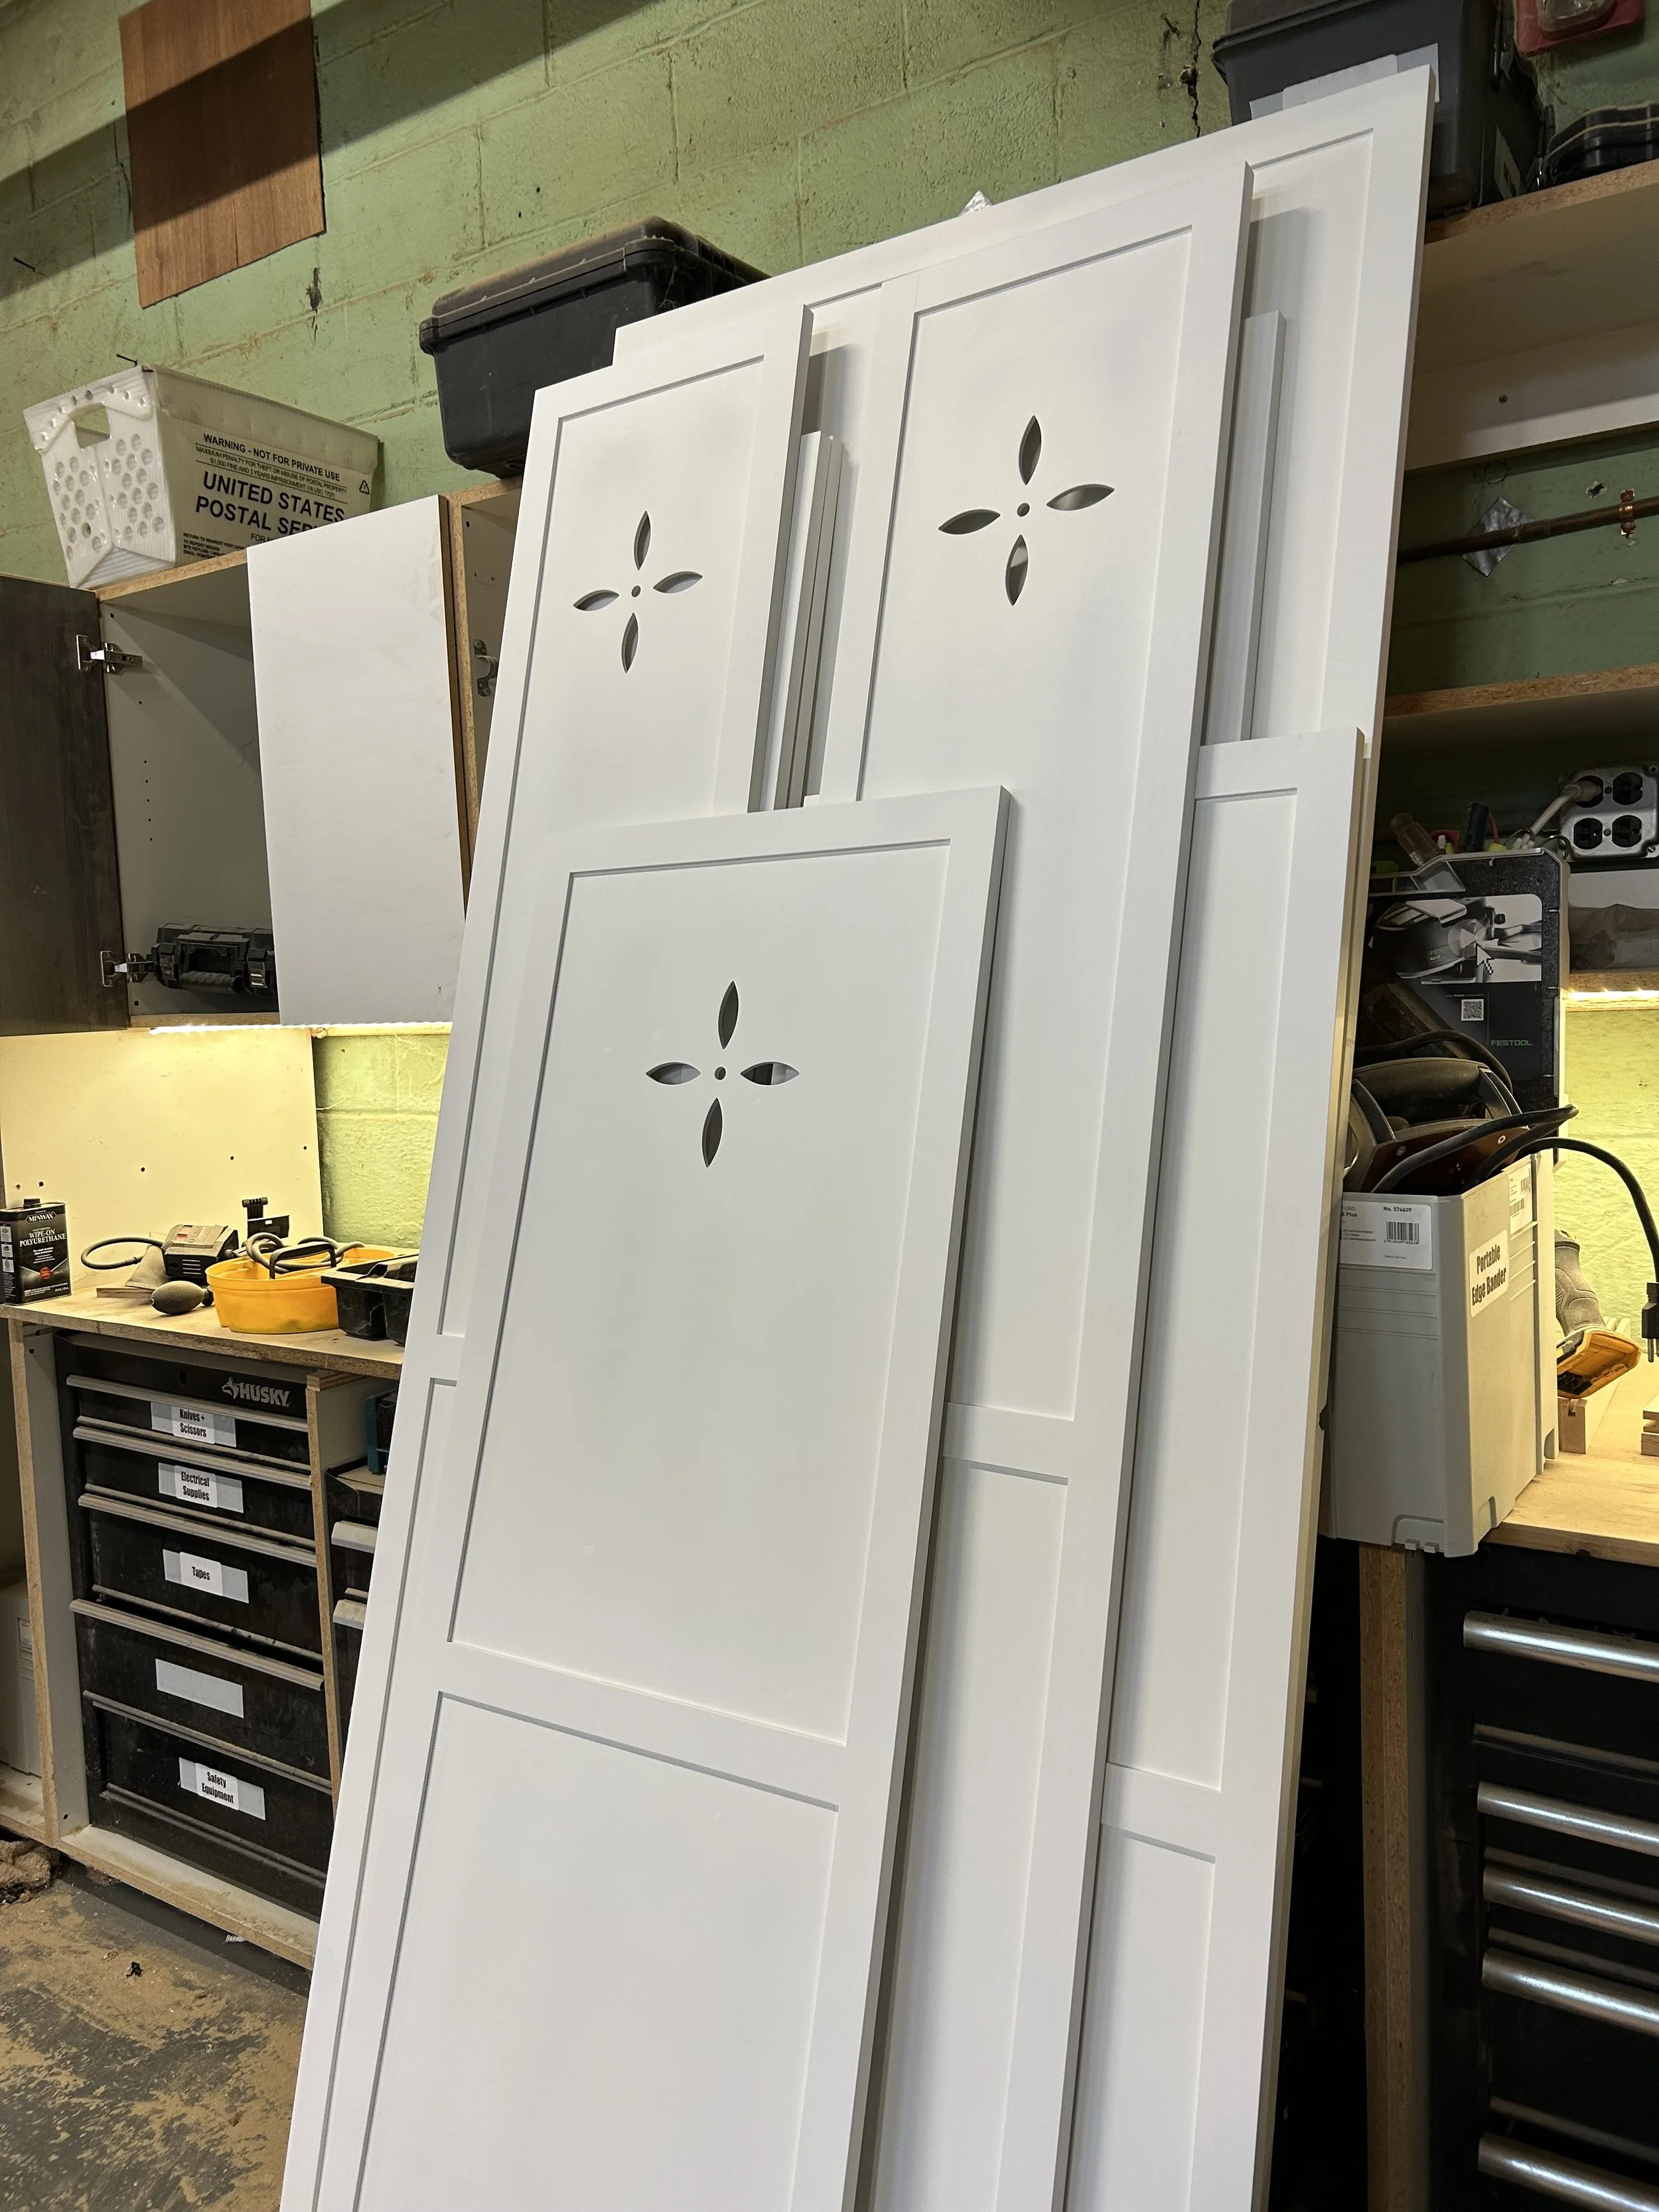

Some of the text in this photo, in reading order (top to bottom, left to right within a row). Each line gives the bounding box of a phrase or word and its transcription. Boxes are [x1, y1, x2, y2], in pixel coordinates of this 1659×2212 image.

[204, 433, 246, 453] WARNING
[253, 448, 270, 460] NOT
[273, 454, 289, 466] FOR
[291, 459, 323, 477] PRIVATE
[325, 469, 340, 482] USE
[196, 446, 222, 458] MAXIMUM
[222, 453, 245, 465] PENALTY
[257, 463, 272, 473] THEFT
[281, 470, 298, 480] MISUSE
[306, 478, 323, 488] POSTAL
[324, 482, 347, 494] PROPERTY
[254, 471, 270, 479] YEARS
[271, 475, 306, 489] IMPRISONMENT
[203, 471, 344, 522] UNITED STATES
[196, 495, 271, 531] POSTAL
[251, 533, 265, 542] FOR
[28, 1213, 54, 1222] MINWAX
[19, 1233, 66, 1247] POLYURETHANE
[29, 1229, 55, 1239] WIPE-ON
[1477, 1244, 1500, 1275] Portable
[1472, 1267, 1507, 1306] Edge Bander
[240, 1382, 291, 1408] HUSKY
[180, 1408, 200, 1422] Knives
[180, 1423, 206, 1438] Scissors
[181, 1471, 210, 1487] Electrical
[183, 1485, 210, 1501] Supplies
[192, 1566, 210, 1580] Tapes
[207, 1771, 226, 1788] Safety
[202, 1783, 234, 1803] Equipment
